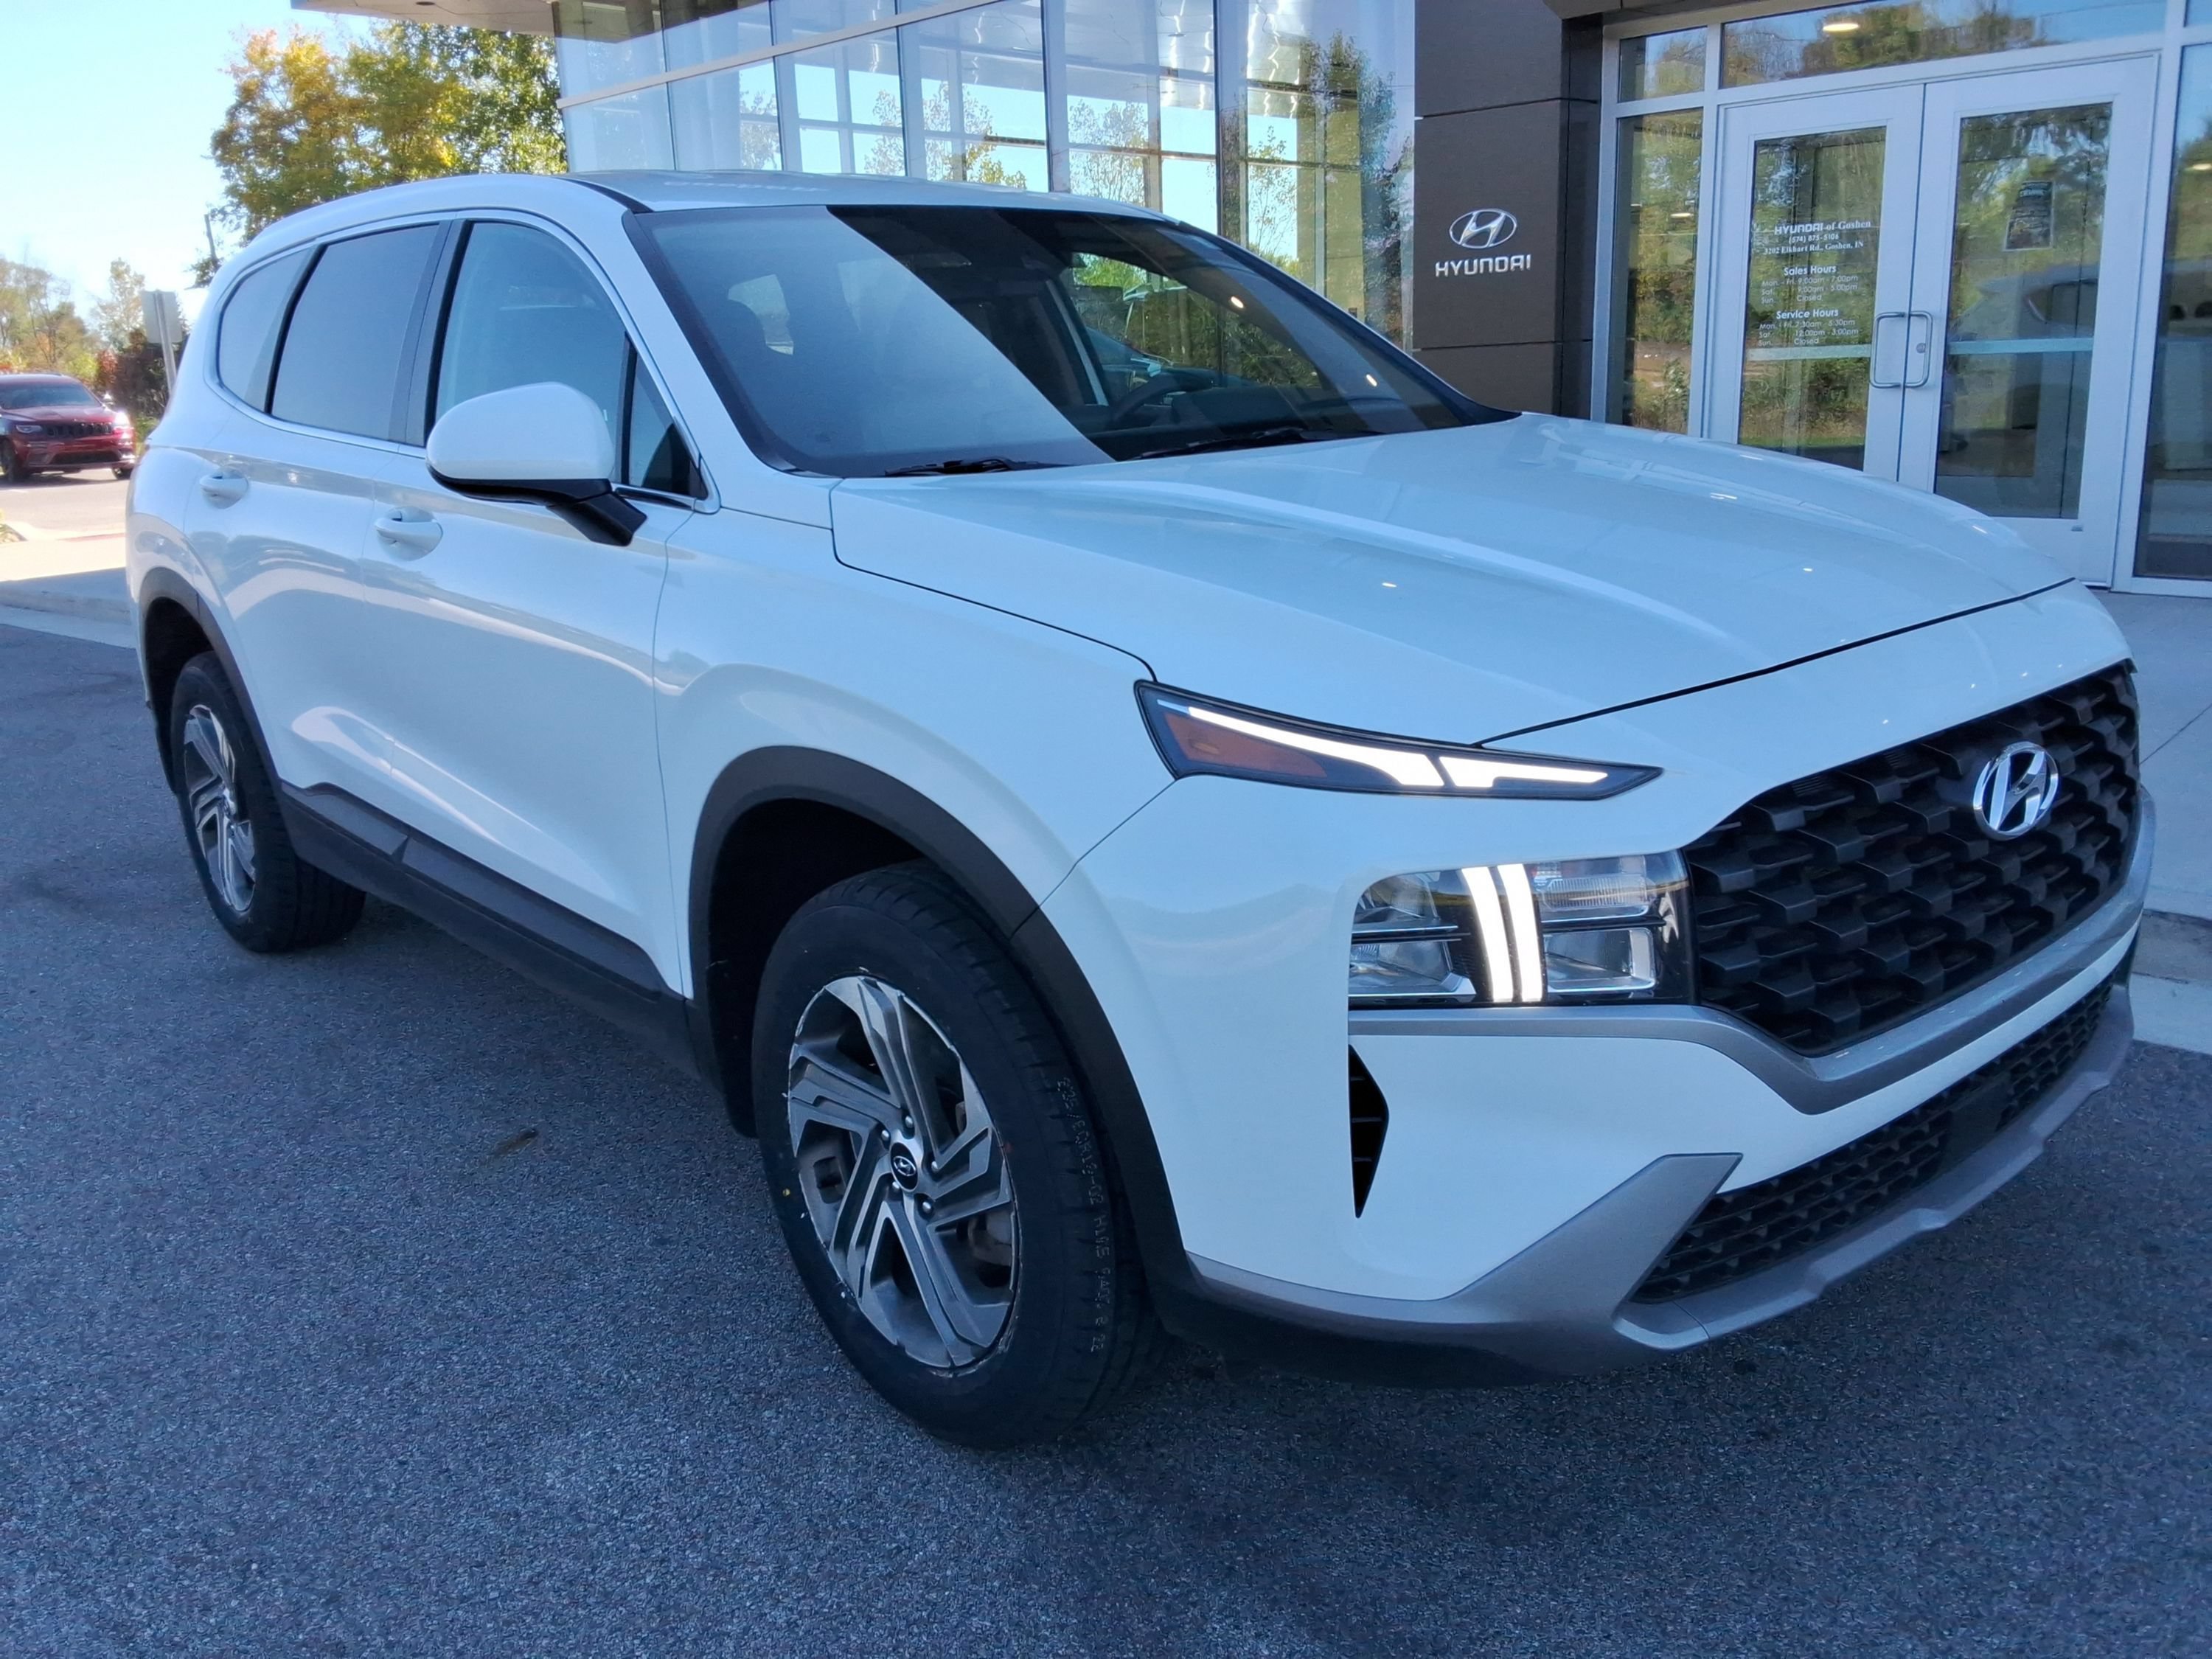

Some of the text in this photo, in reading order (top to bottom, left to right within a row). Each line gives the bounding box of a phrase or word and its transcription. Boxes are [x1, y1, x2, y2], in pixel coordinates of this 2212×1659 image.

[1775, 220, 1871, 234] HYUNDAI of Goshen
[1781, 245, 1808, 254] Elkhart
[1435, 254, 1531, 277] HYUNDAI
[1784, 265, 1837, 276] Sales Hours
[1775, 309, 1839, 319] Service Hours
